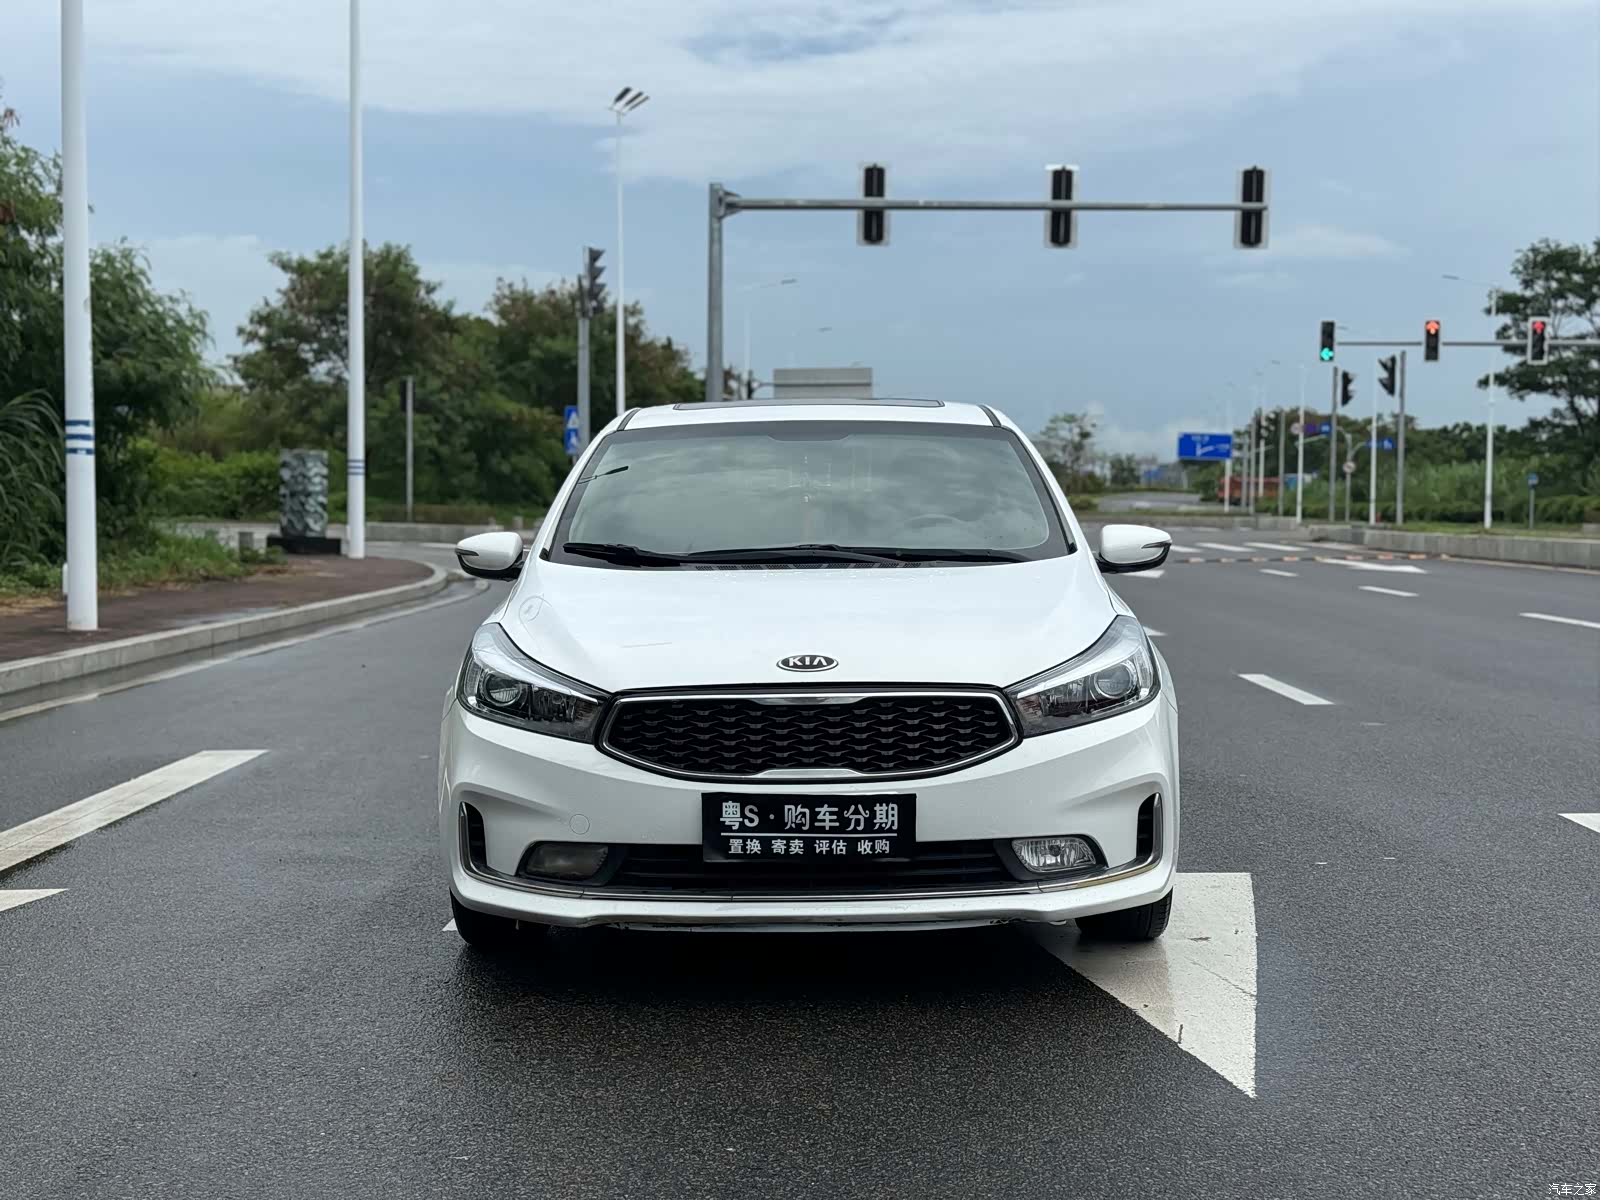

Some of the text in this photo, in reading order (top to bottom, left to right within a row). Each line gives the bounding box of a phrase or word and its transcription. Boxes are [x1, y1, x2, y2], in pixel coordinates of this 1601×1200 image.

[788, 656, 828, 667] KIA
[728, 838, 890, 855] 置换 寄卖 评估 收购
